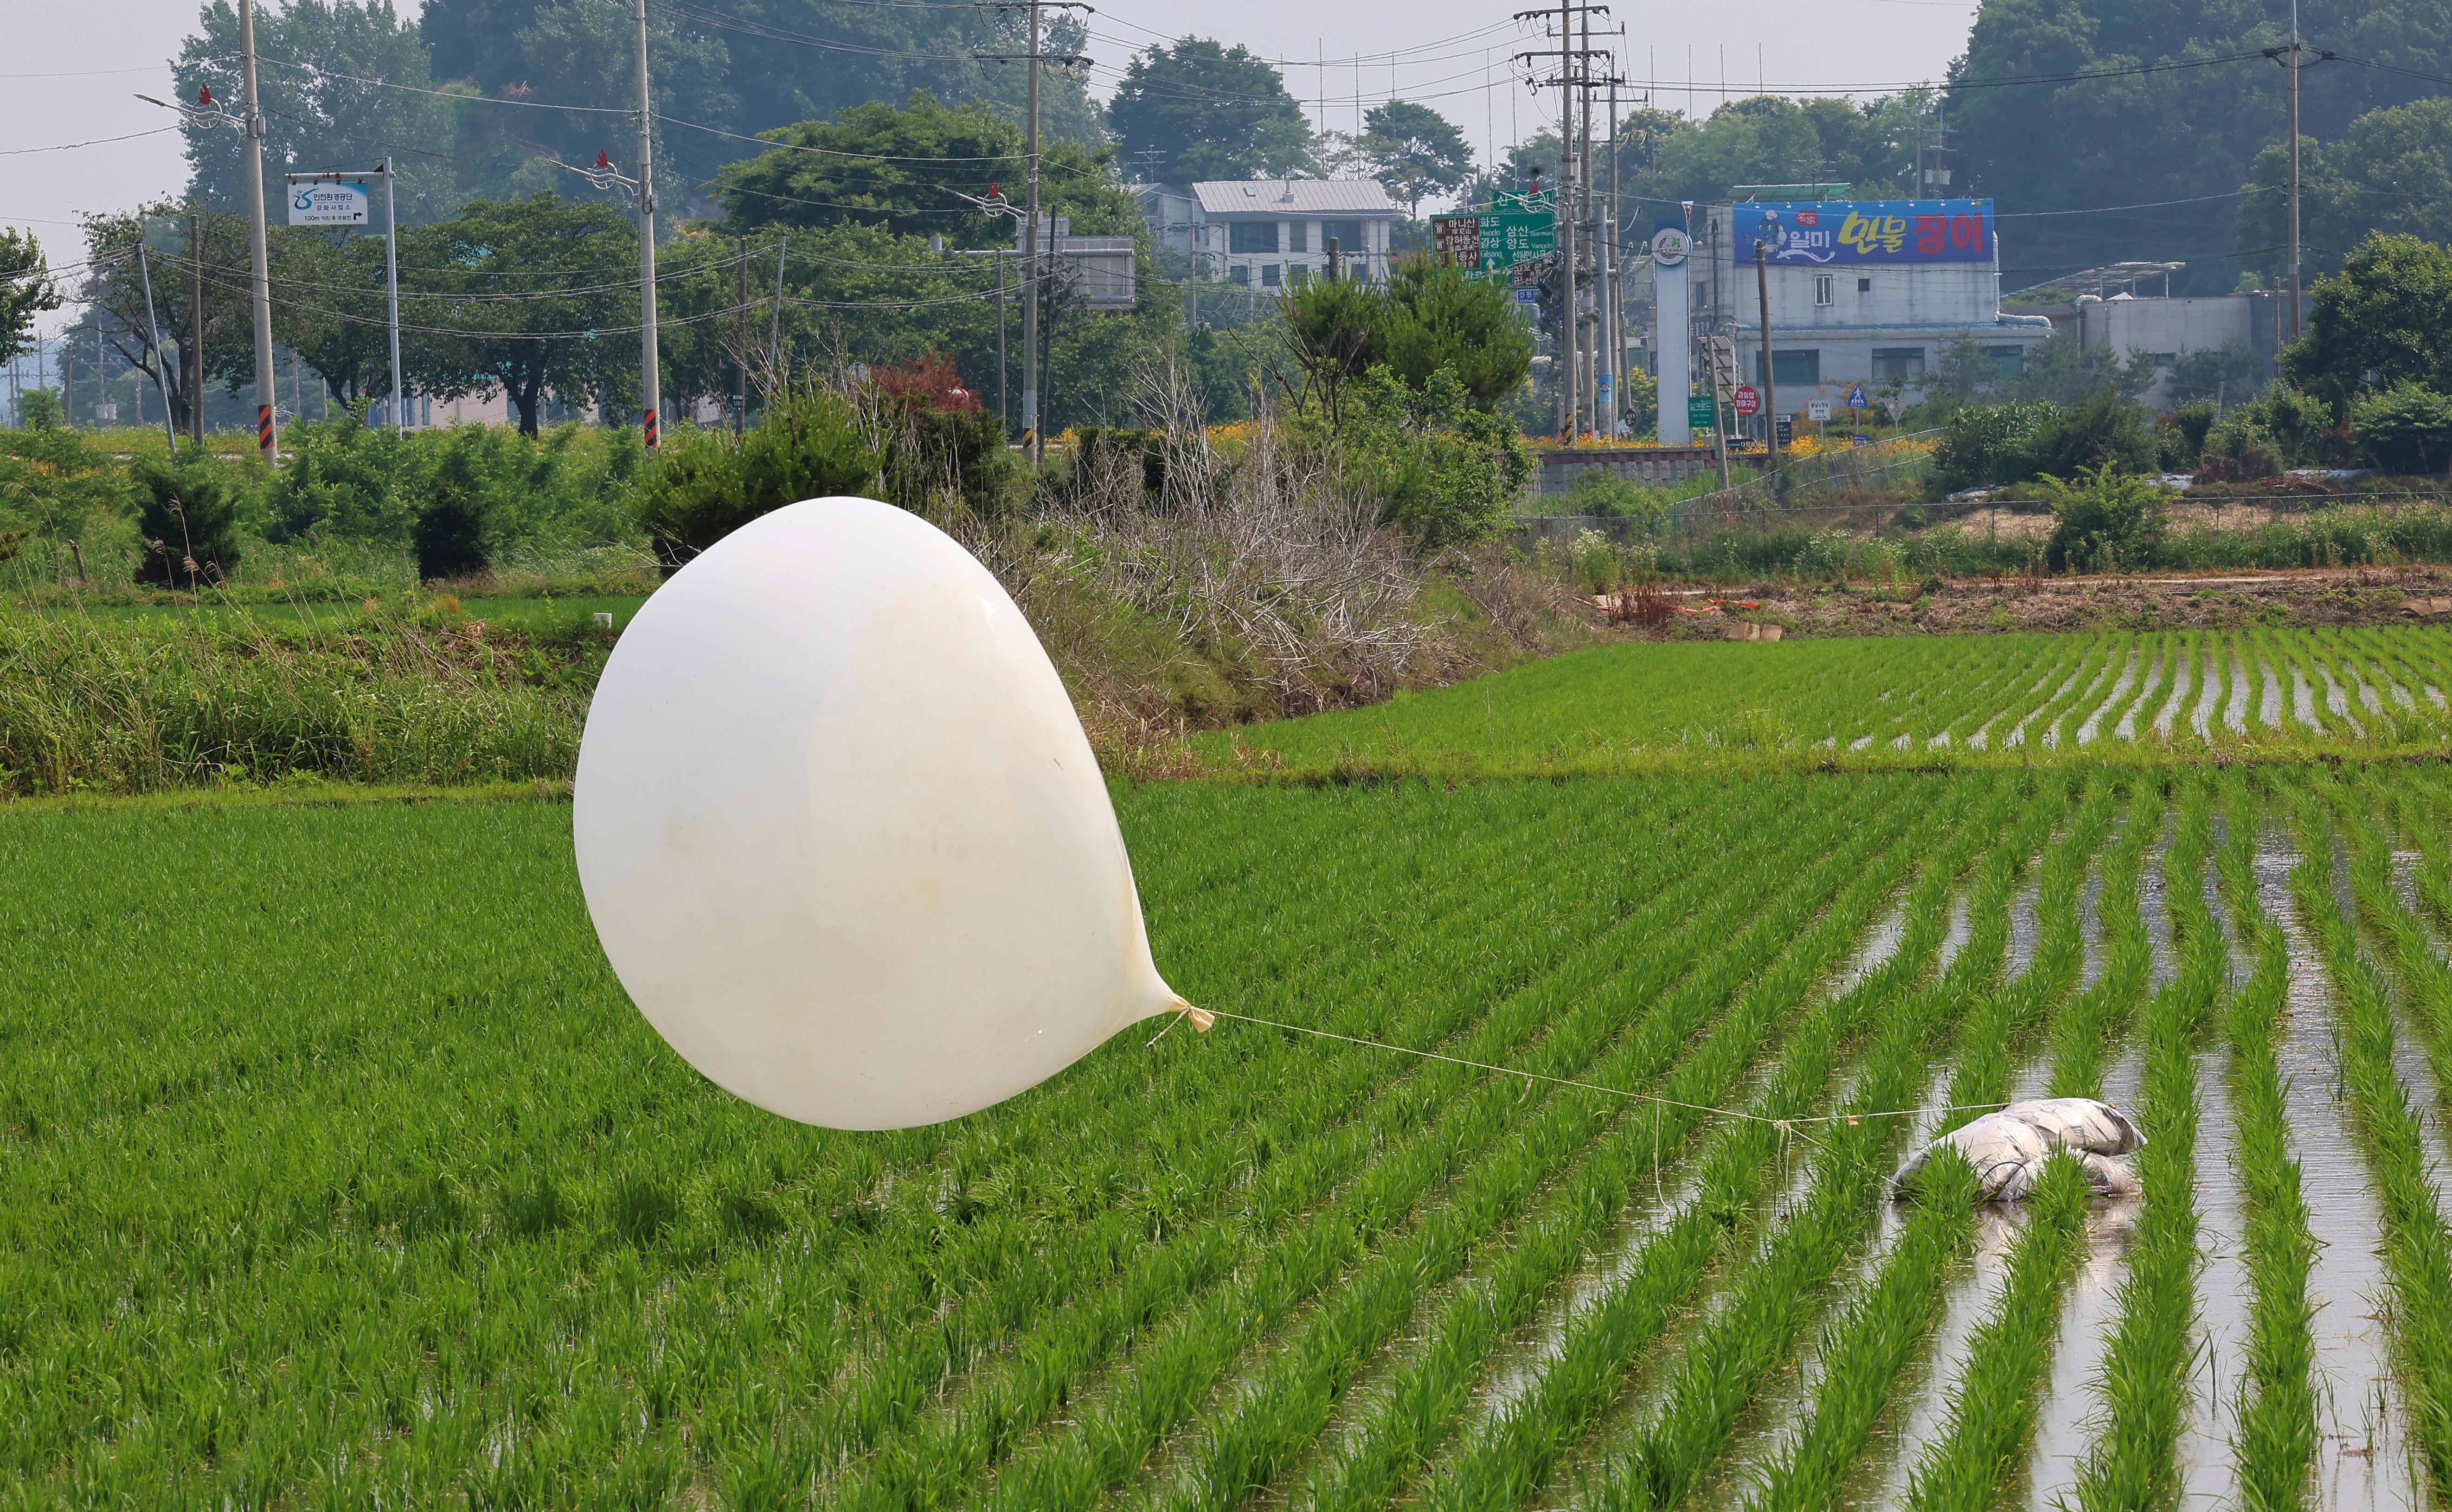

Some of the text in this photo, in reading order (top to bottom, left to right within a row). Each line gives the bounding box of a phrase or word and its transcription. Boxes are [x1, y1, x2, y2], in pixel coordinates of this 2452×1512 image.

[1449, 218, 1476, 229] 마니산
[1480, 217, 1501, 227] 화도
[1797, 213, 1816, 224] 名家
[1506, 225, 1529, 237] 삼산
[1790, 211, 1983, 255] 일미 민물 장어
[1481, 237, 1500, 249] 길상
[1506, 238, 1529, 250] 양도
[1481, 250, 1502, 258] Gilsang
